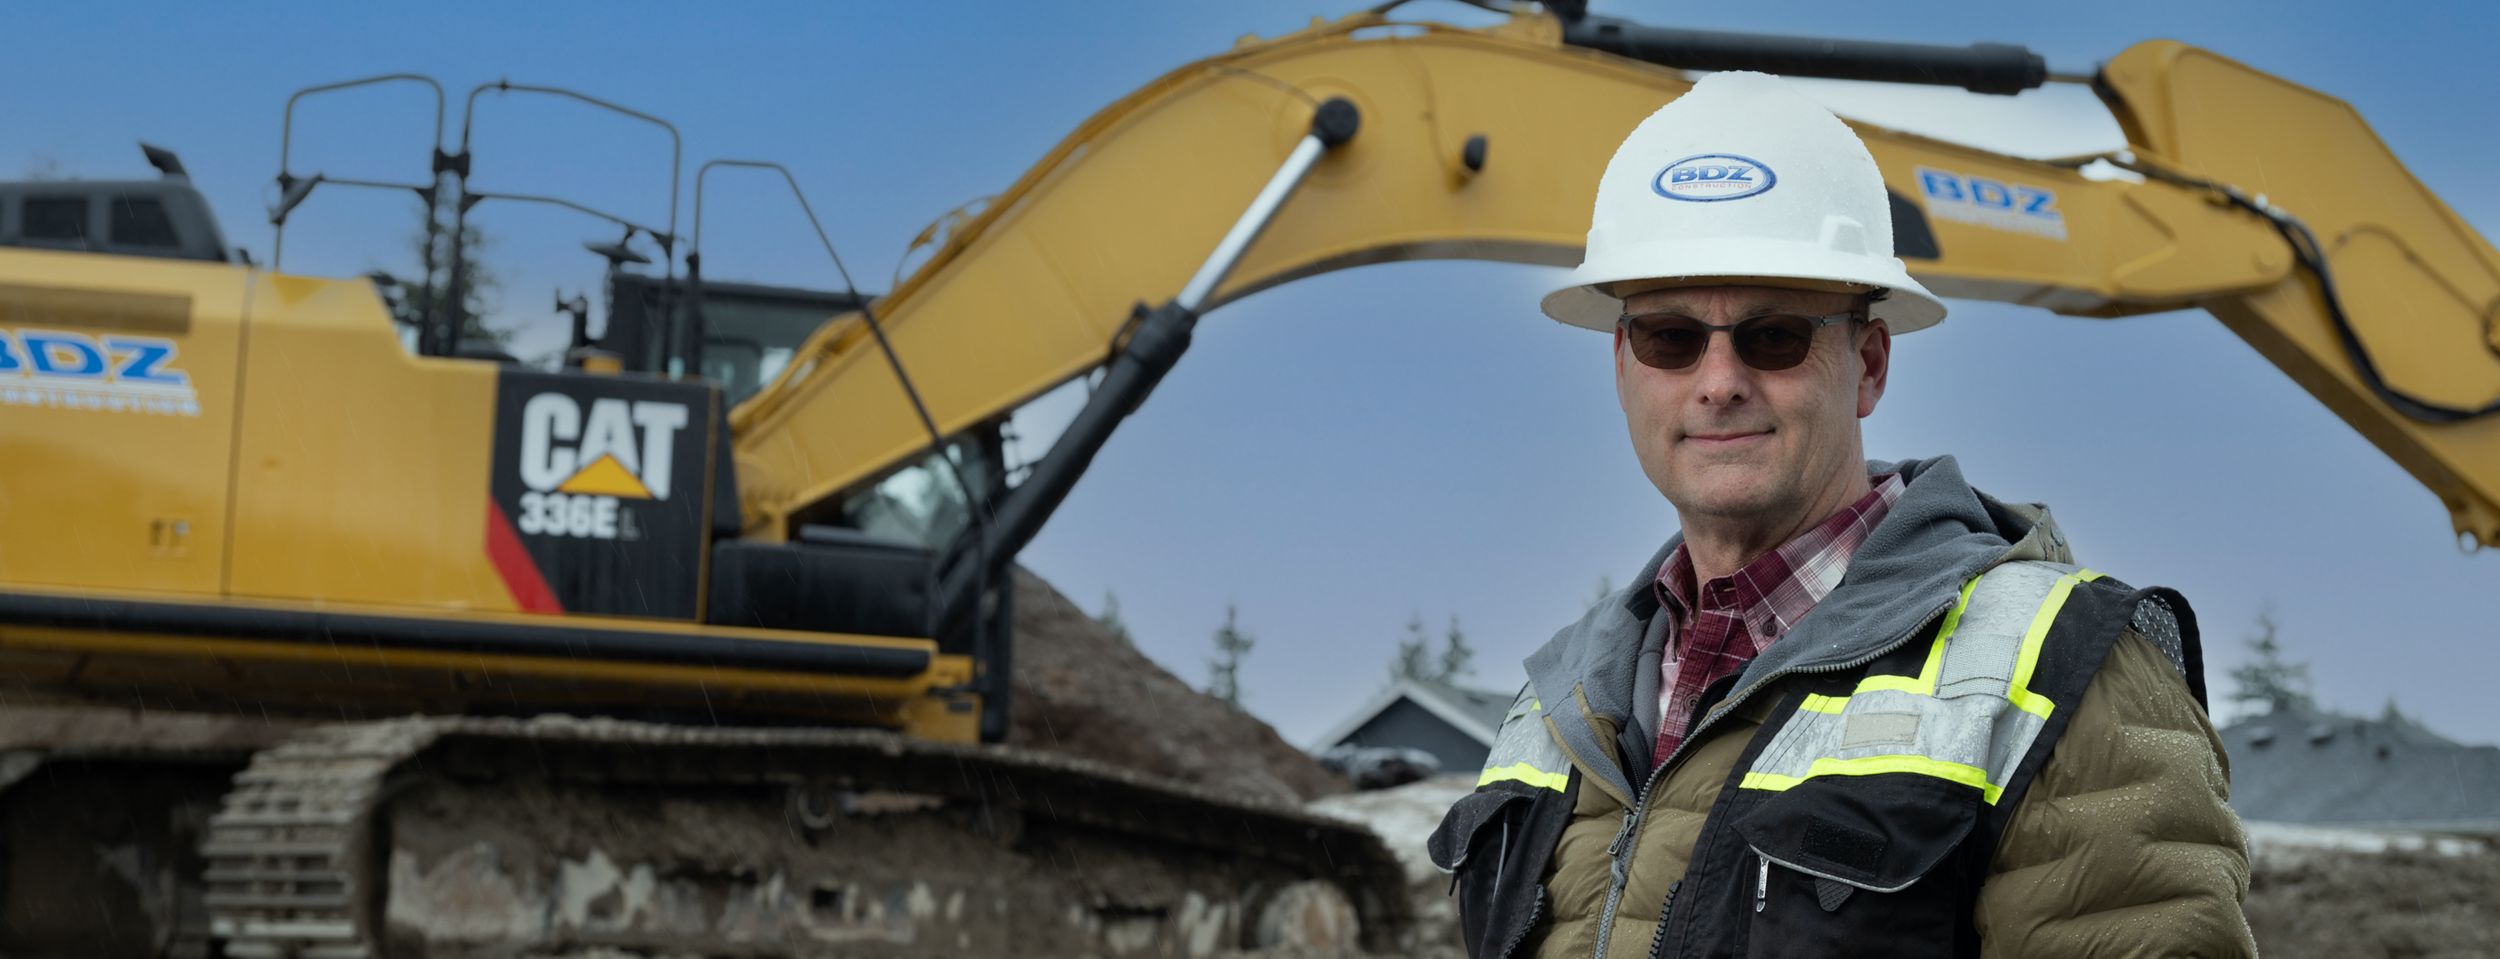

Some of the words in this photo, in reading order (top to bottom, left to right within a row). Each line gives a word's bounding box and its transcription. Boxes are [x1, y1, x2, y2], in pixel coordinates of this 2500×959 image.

[1671, 165, 1754, 182] BDZ
[1671, 181, 1752, 191] CONSTRUCTION
[1917, 168, 2063, 221] BDZ
[520, 392, 689, 501] CAT
